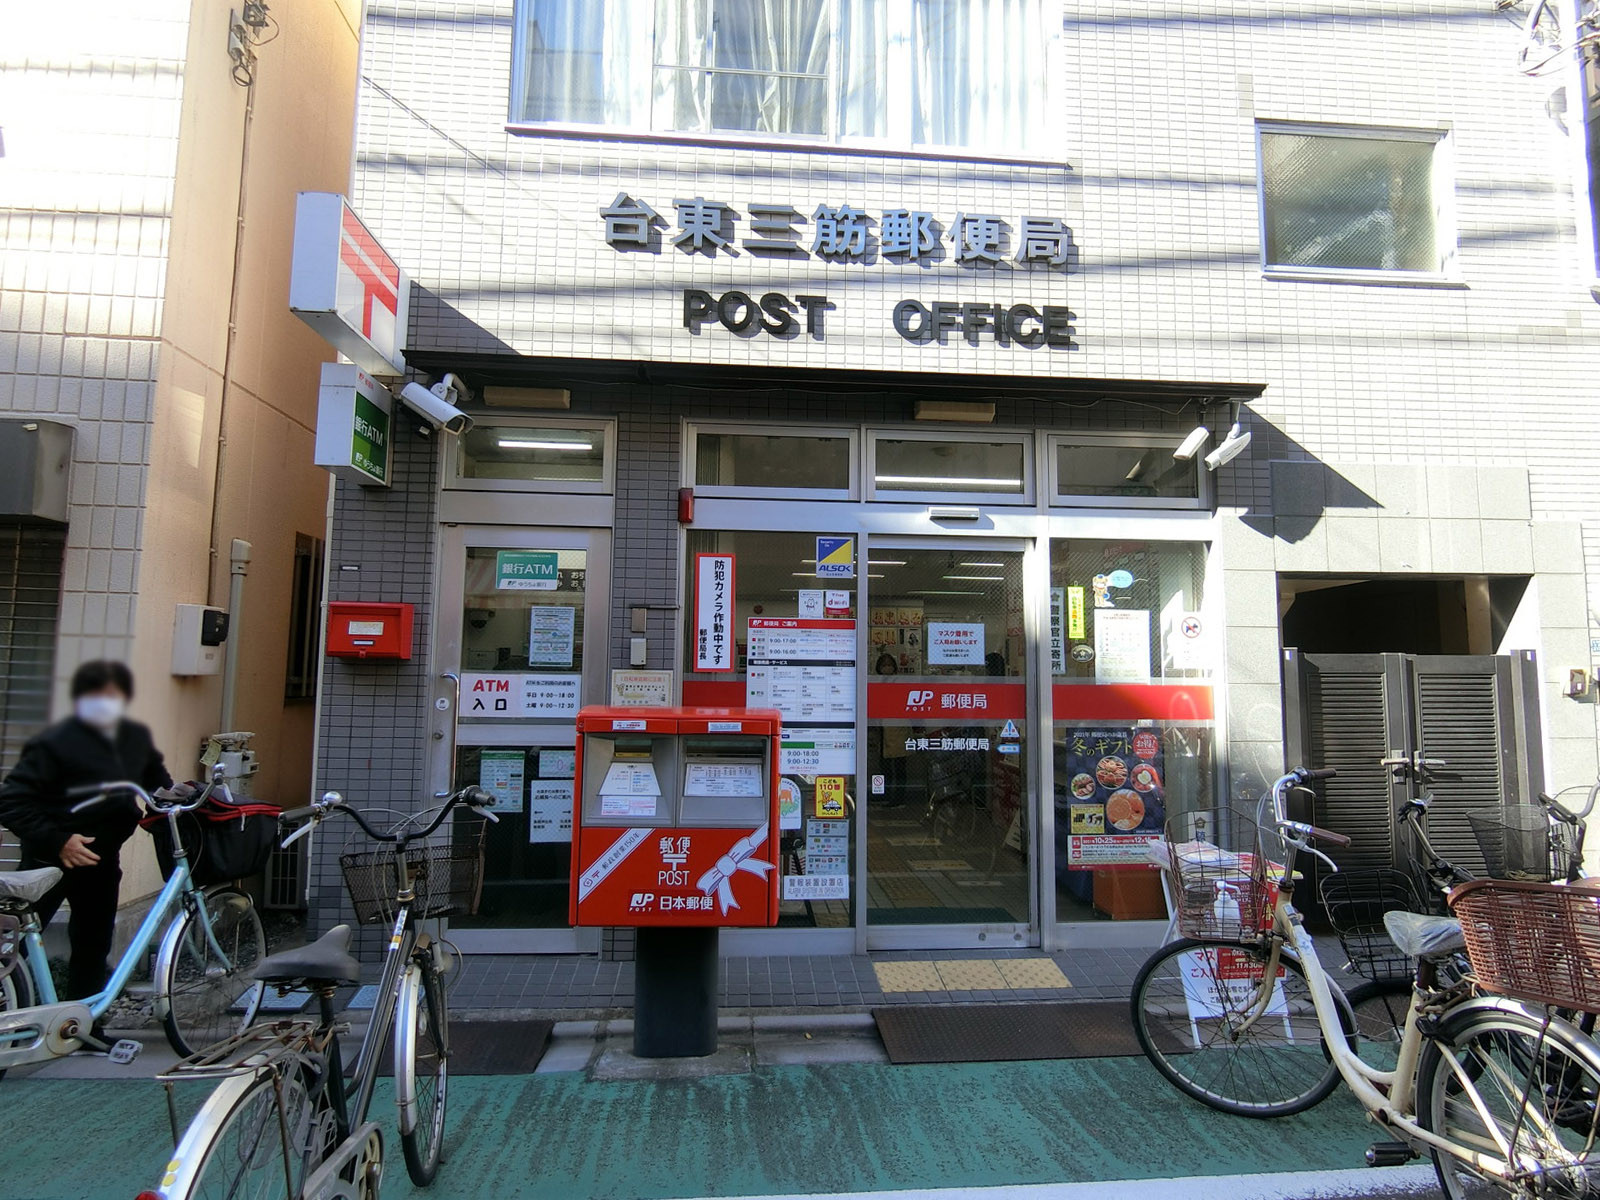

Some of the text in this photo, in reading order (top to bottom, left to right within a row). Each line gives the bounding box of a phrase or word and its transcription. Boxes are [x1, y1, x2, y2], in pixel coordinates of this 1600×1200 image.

[599, 192, 1070, 266] 台東三筋郵便局
[683, 288, 1073, 346] POST OFFICE
[354, 415, 384, 447] 銀行ATM
[502, 563, 553, 575] 銀行ATM
[818, 564, 852, 572] ALSOK
[712, 560, 725, 665] 防犯カメラ作動中です
[699, 628, 708, 660] 郵便局長
[1050, 605, 1062, 670] 警察官立寄所
[473, 680, 509, 692] ATM
[472, 698, 507, 710] 入口
[940, 693, 987, 709] 郵便局
[904, 738, 990, 751] 台東三筋郵便局
[1071, 738, 1133, 757] 冬のギフト
[659, 836, 691, 855] 郵便
[658, 870, 690, 886] POST
[659, 896, 714, 910] 日本郵便
